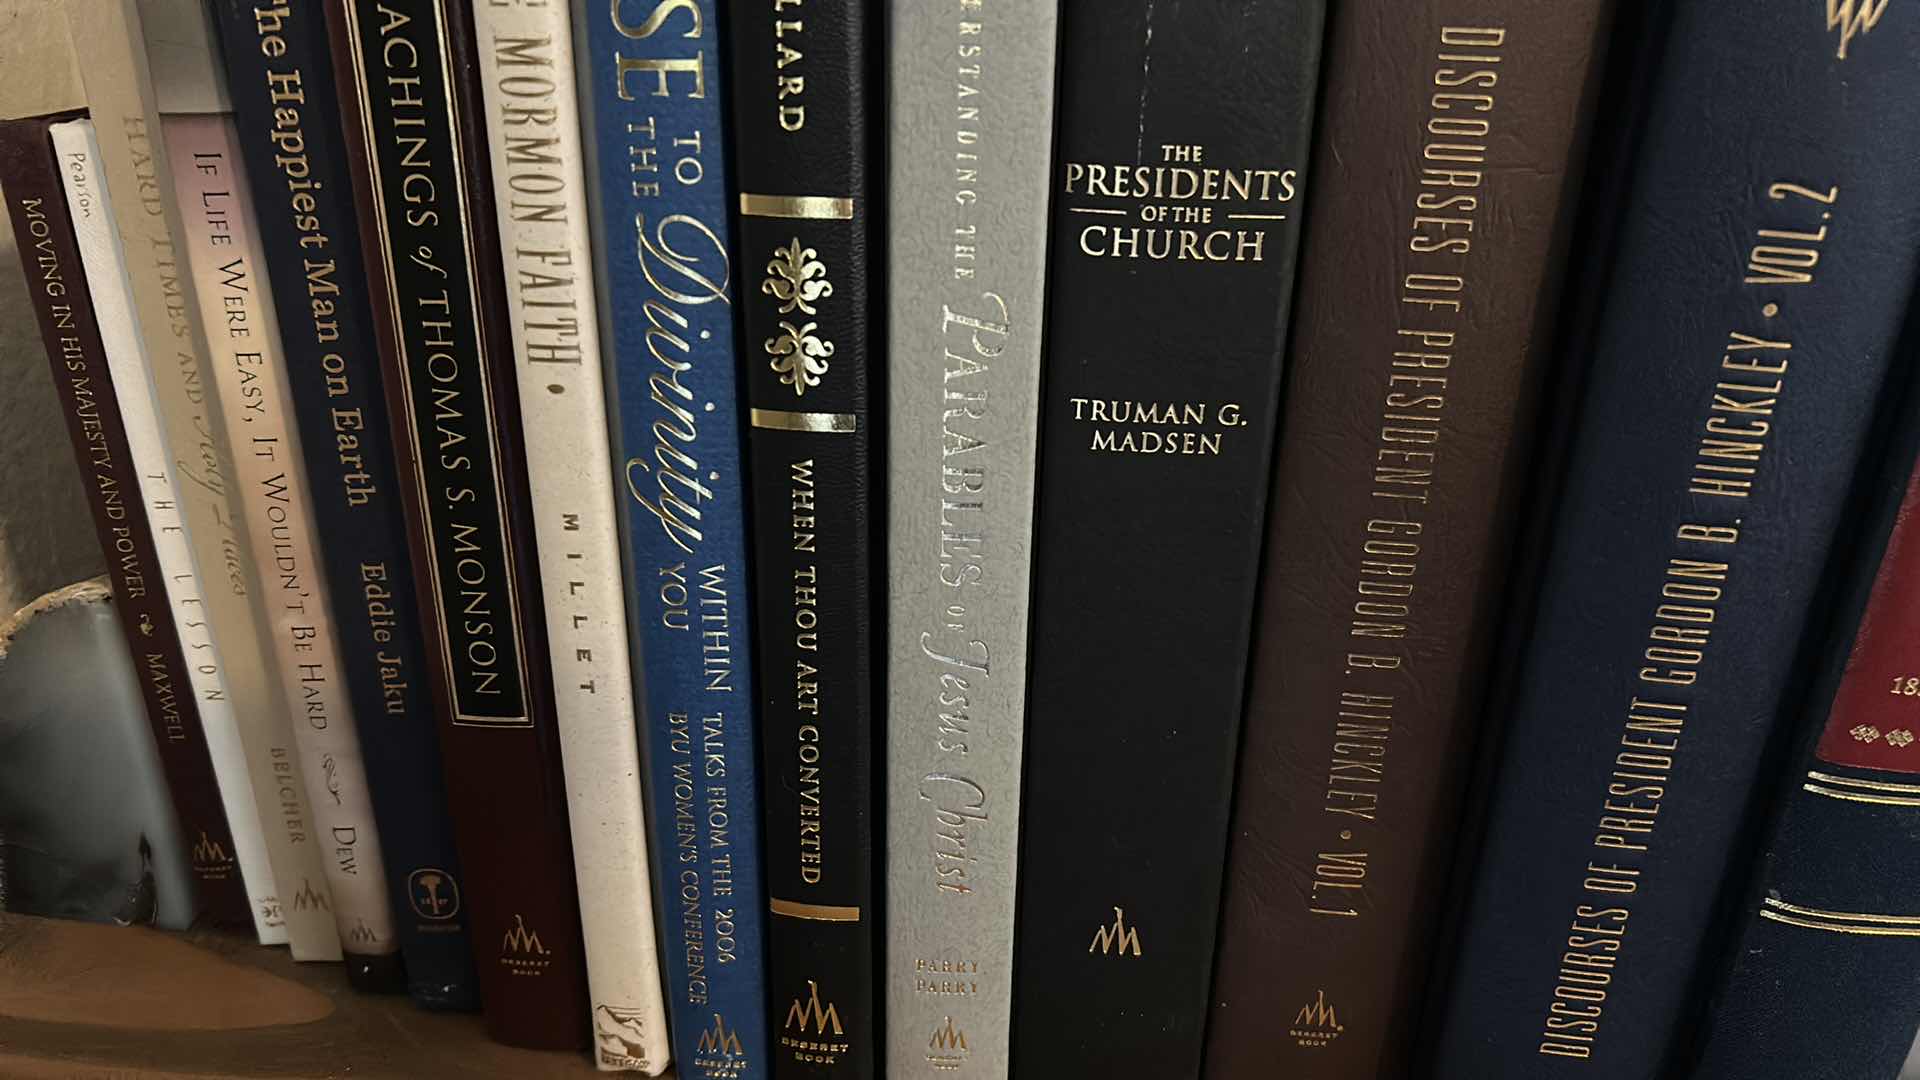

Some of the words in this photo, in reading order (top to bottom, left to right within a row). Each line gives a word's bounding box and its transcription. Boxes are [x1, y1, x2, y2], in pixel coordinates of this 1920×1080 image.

[377, 3, 439, 228] ACHINGS
[493, 36, 568, 226] MORMON
[1410, 26, 1507, 253] DISCOURSES
[66, 153, 92, 218] Pearson
[193, 152, 222, 177] IF
[267, 69, 329, 249] Happiest
[627, 117, 660, 198] THE
[673, 131, 703, 185] TO
[1064, 163, 1297, 202] PRESIDENTS
[1161, 144, 1203, 162] THE
[23, 198, 64, 296] MOVING
[202, 192, 231, 247] LIFE
[1079, 225, 1266, 262] CHURCH
[1140, 205, 1168, 223] OF
[1171, 206, 1212, 224] THE
[124, 115, 161, 215] HARD
[150, 234, 190, 337] TIMES
[178, 352, 202, 405] AND
[409, 246, 448, 279] of
[954, 224, 976, 281] THE
[53, 304, 74, 329] IN
[219, 258, 249, 340] WERE
[304, 259, 341, 344] Man
[516, 247, 583, 367] FAITH
[1402, 273, 1464, 313] OF
[61, 336, 86, 374] HIS
[236, 352, 266, 423] EASY,
[323, 353, 350, 398] on
[419, 290, 471, 473] THOMAS
[625, 212, 731, 555] Divinity
[72, 378, 113, 467] MAJESTY
[938, 291, 1009, 589] PARABLES
[1070, 398, 1205, 425] TRUMAN
[1217, 404, 1248, 426] G.
[1090, 430, 1222, 455] MADSEN
[1372, 329, 1455, 504] PRESIDENT
[1689, 331, 1792, 497] HINCKLEY
[253, 437, 278, 462] IT
[332, 408, 377, 507] Earth
[97, 472, 126, 521] AND
[446, 486, 475, 511] S.
[791, 459, 816, 553] WHEN
[1677, 518, 1741, 544] B.
[112, 526, 145, 598] POWER
[261, 474, 310, 615] WOULDN'T
[1351, 519, 1422, 638] GORDON
[148, 472, 183, 535] THE
[174, 574, 225, 702] LESSON
[361, 562, 396, 643] Eddie
[451, 522, 501, 696] MONSON
[562, 513, 595, 695] MILLET
[659, 561, 688, 631] YOU
[794, 565, 818, 652] THOU
[1639, 559, 1729, 685] GORDON
[291, 624, 316, 653] BE
[699, 564, 734, 692] WITHIN
[1345, 653, 1400, 674] B.
[147, 654, 184, 742] MAXWELL
[298, 664, 327, 731] HARD
[378, 651, 408, 715] Jaku
[796, 660, 819, 714] ART
[919, 630, 990, 756] Jesus
[1890, 677, 1920, 696] 18
[668, 712, 690, 755] BYU
[702, 712, 726, 778] TALKS
[1325, 692, 1394, 820] HINCKLEY
[797, 725, 822, 885] CONVERTED
[1594, 696, 1688, 851] PRESIDENT
[672, 762, 699, 865] WOMEN'S
[706, 787, 731, 850] FROM
[918, 772, 988, 896] Christ
[332, 826, 359, 876] DEW
[711, 853, 733, 897] THE
[1584, 860, 1640, 893] OF
[680, 869, 708, 1006] CONFERENCE
[714, 908, 736, 964] 2006
[915, 958, 979, 975] PARRY
[915, 979, 979, 995] PARRY
[1539, 905, 1630, 1058] DISCOURSES
